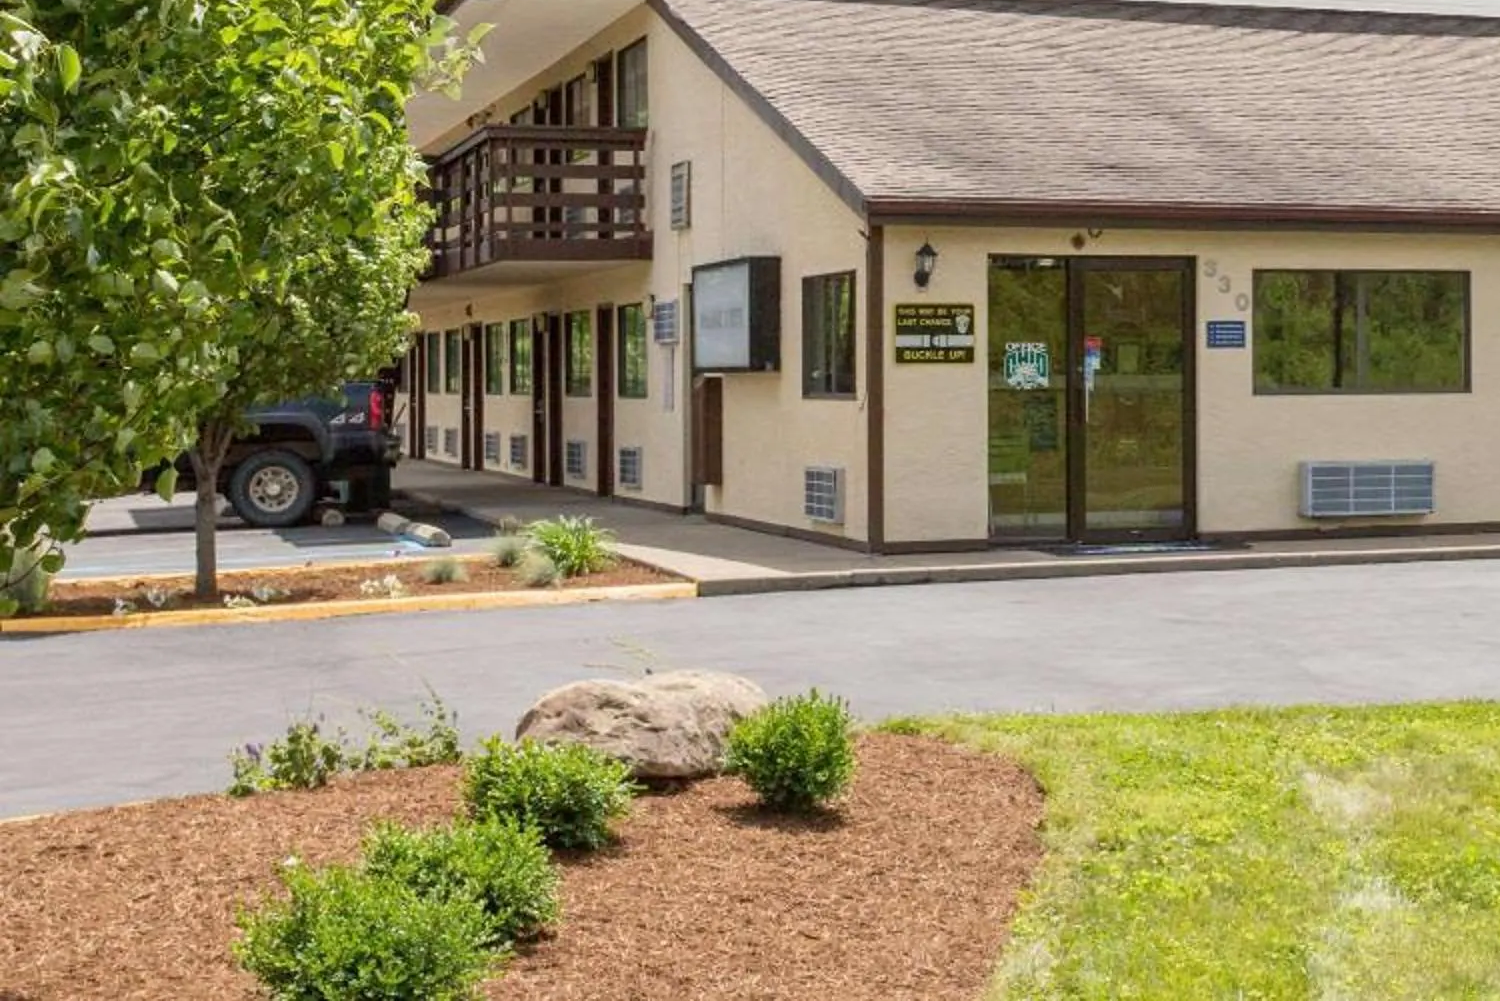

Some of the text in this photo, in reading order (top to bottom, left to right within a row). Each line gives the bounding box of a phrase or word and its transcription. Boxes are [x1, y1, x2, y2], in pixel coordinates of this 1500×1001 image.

[1203, 260, 1249, 312] 330
[897, 318, 917, 327] LAST
[1005, 342, 1048, 351] OFFICE
[903, 350, 945, 360] BUCKLE
